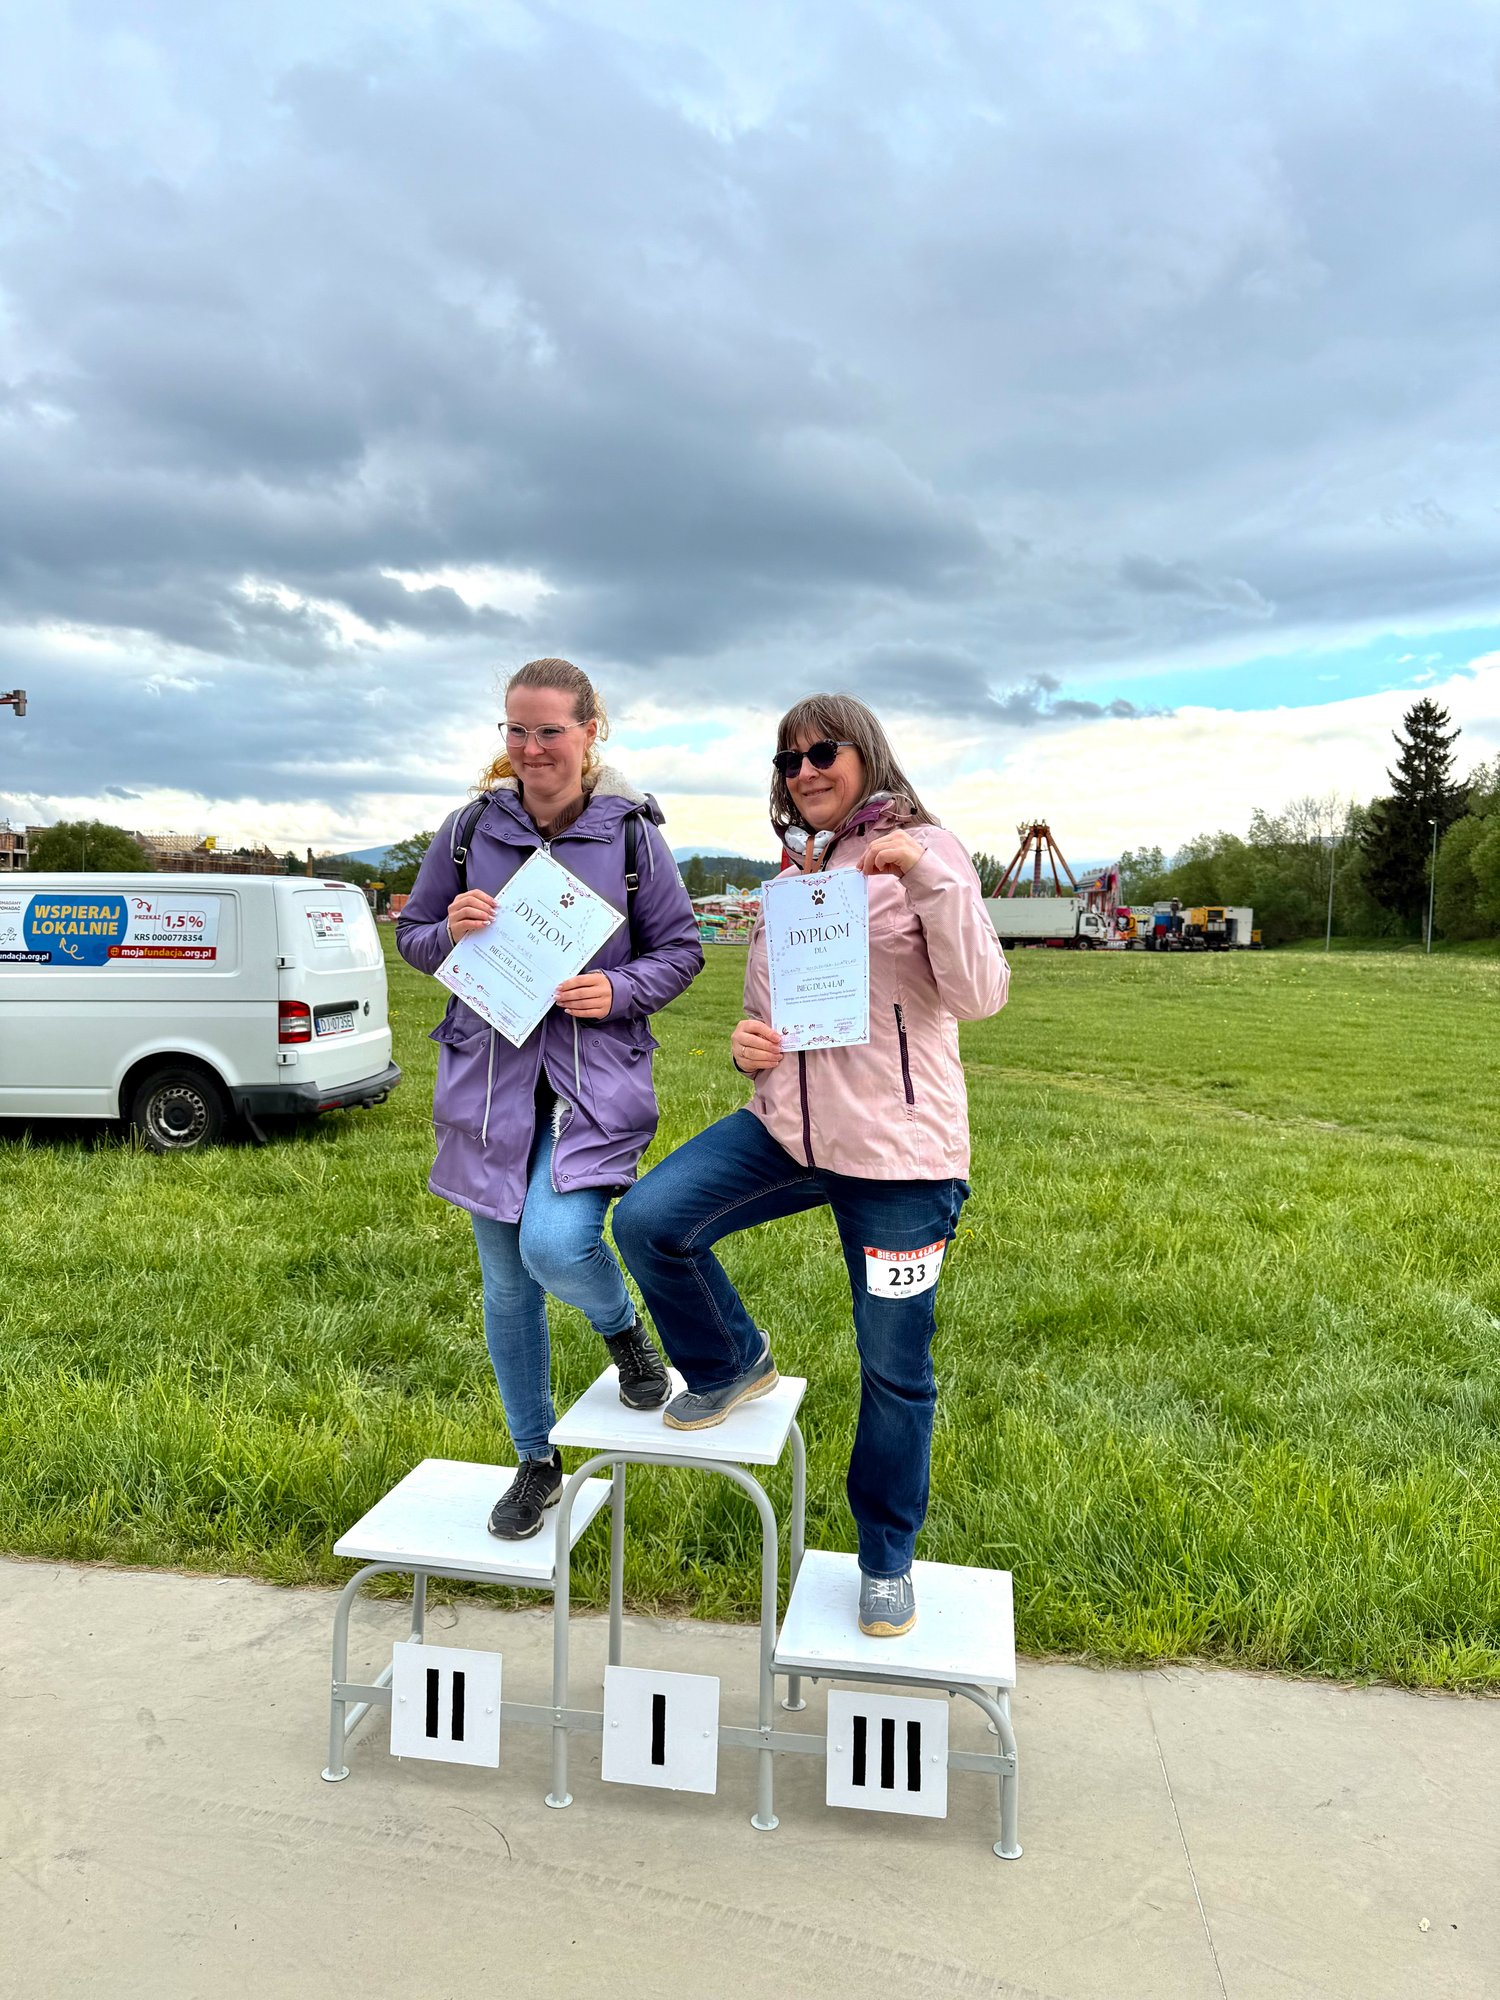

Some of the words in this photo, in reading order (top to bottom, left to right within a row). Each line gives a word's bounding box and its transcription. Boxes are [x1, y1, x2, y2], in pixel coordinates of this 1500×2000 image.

[34, 905, 121, 920] WSPIERAJ
[32, 921, 119, 936] LOKALNIE
[514, 901, 573, 953] DYPLOM
[789, 922, 850, 946] DYPLOM
[134, 933, 150, 941] KRS
[151, 933, 203, 942] 0000778354
[527, 931, 540, 945] DLA
[121, 947, 212, 959] mojafundacja.org.pl
[489, 944, 504, 961] BIEG
[503, 957, 517, 971] DLA
[814, 946, 828, 954] DLA
[796, 983, 813, 992] BIEG
[813, 981, 827, 990] DLA
[877, 1250, 897, 1261] BIEG
[898, 1252, 917, 1261] DLA
[917, 1250, 923, 1258] 4
[889, 1264, 926, 1285] 233
[426, 1668, 465, 1741] II
[851, 1715, 922, 1792] III
